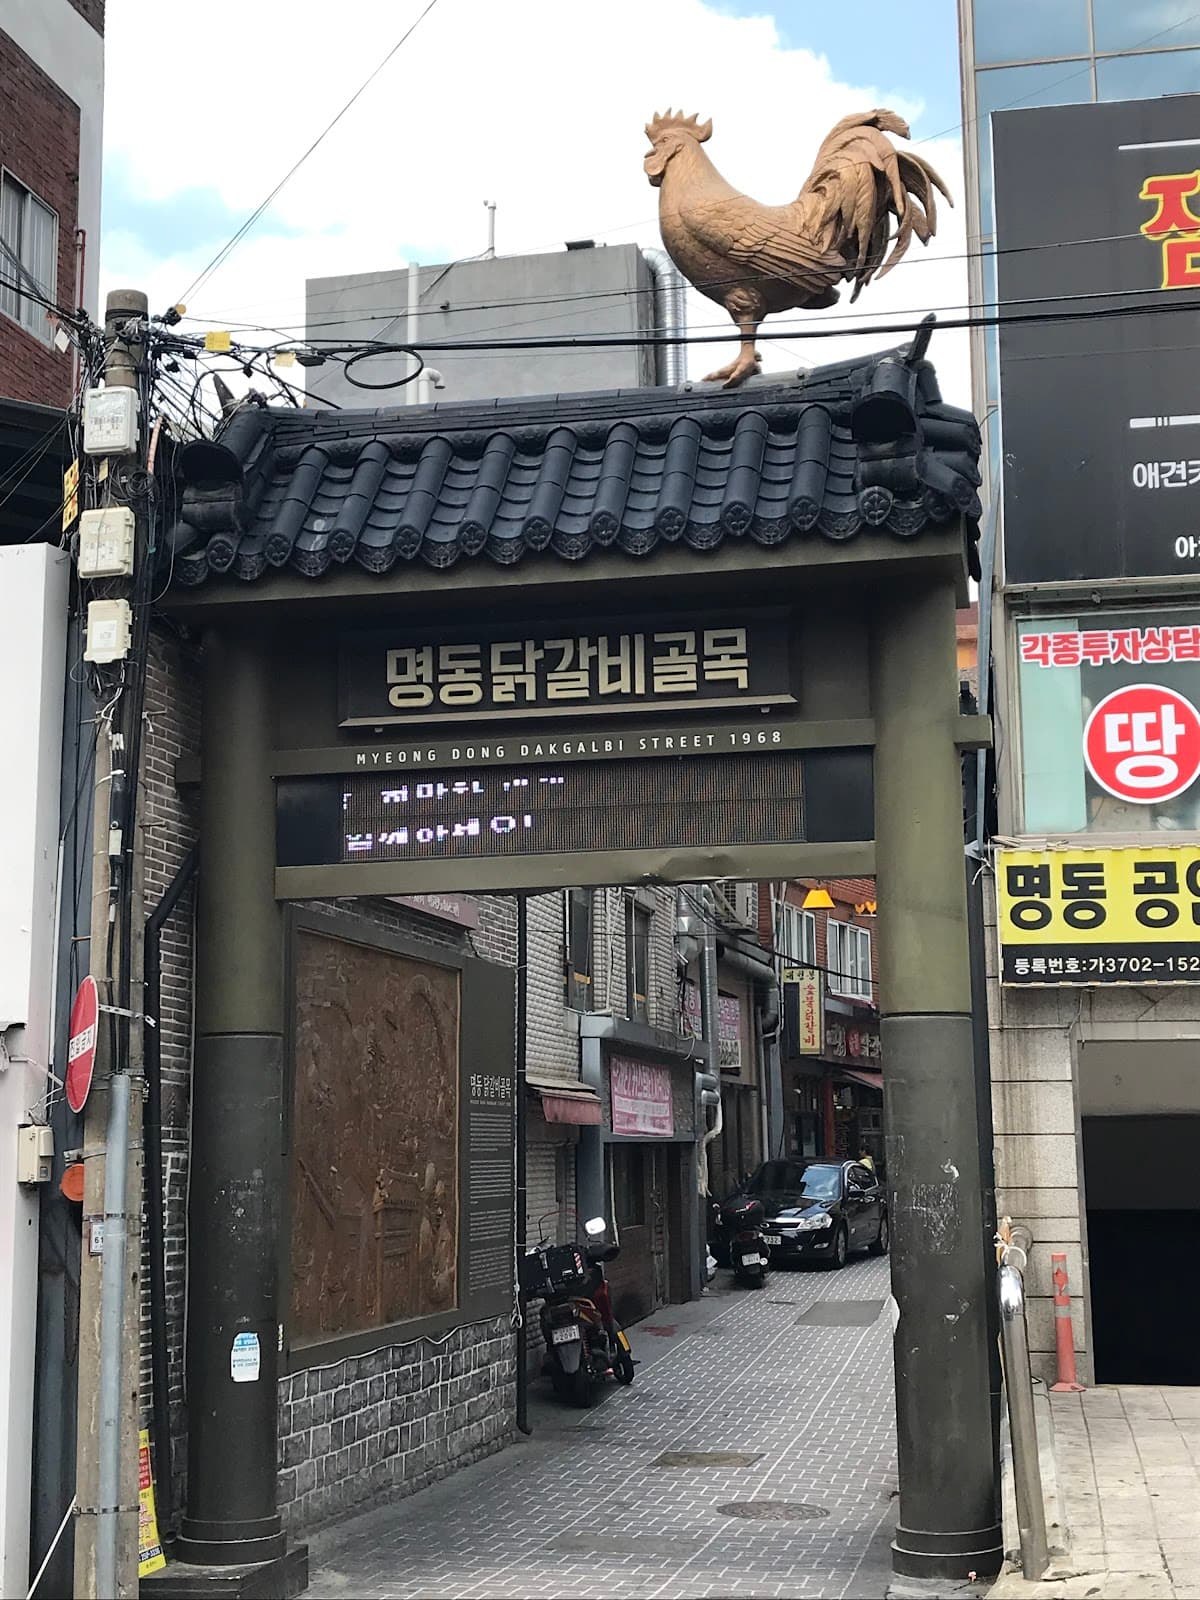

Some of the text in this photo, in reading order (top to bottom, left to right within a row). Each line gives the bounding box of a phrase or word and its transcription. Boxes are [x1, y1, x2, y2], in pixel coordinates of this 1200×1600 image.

[386, 627, 749, 709] 명동닭갈비골목
[356, 731, 783, 765] MYEONG DONG DAKGALBI STREET 1968
[1104, 704, 1186, 789] 땅
[1006, 862, 1107, 931] 명동
